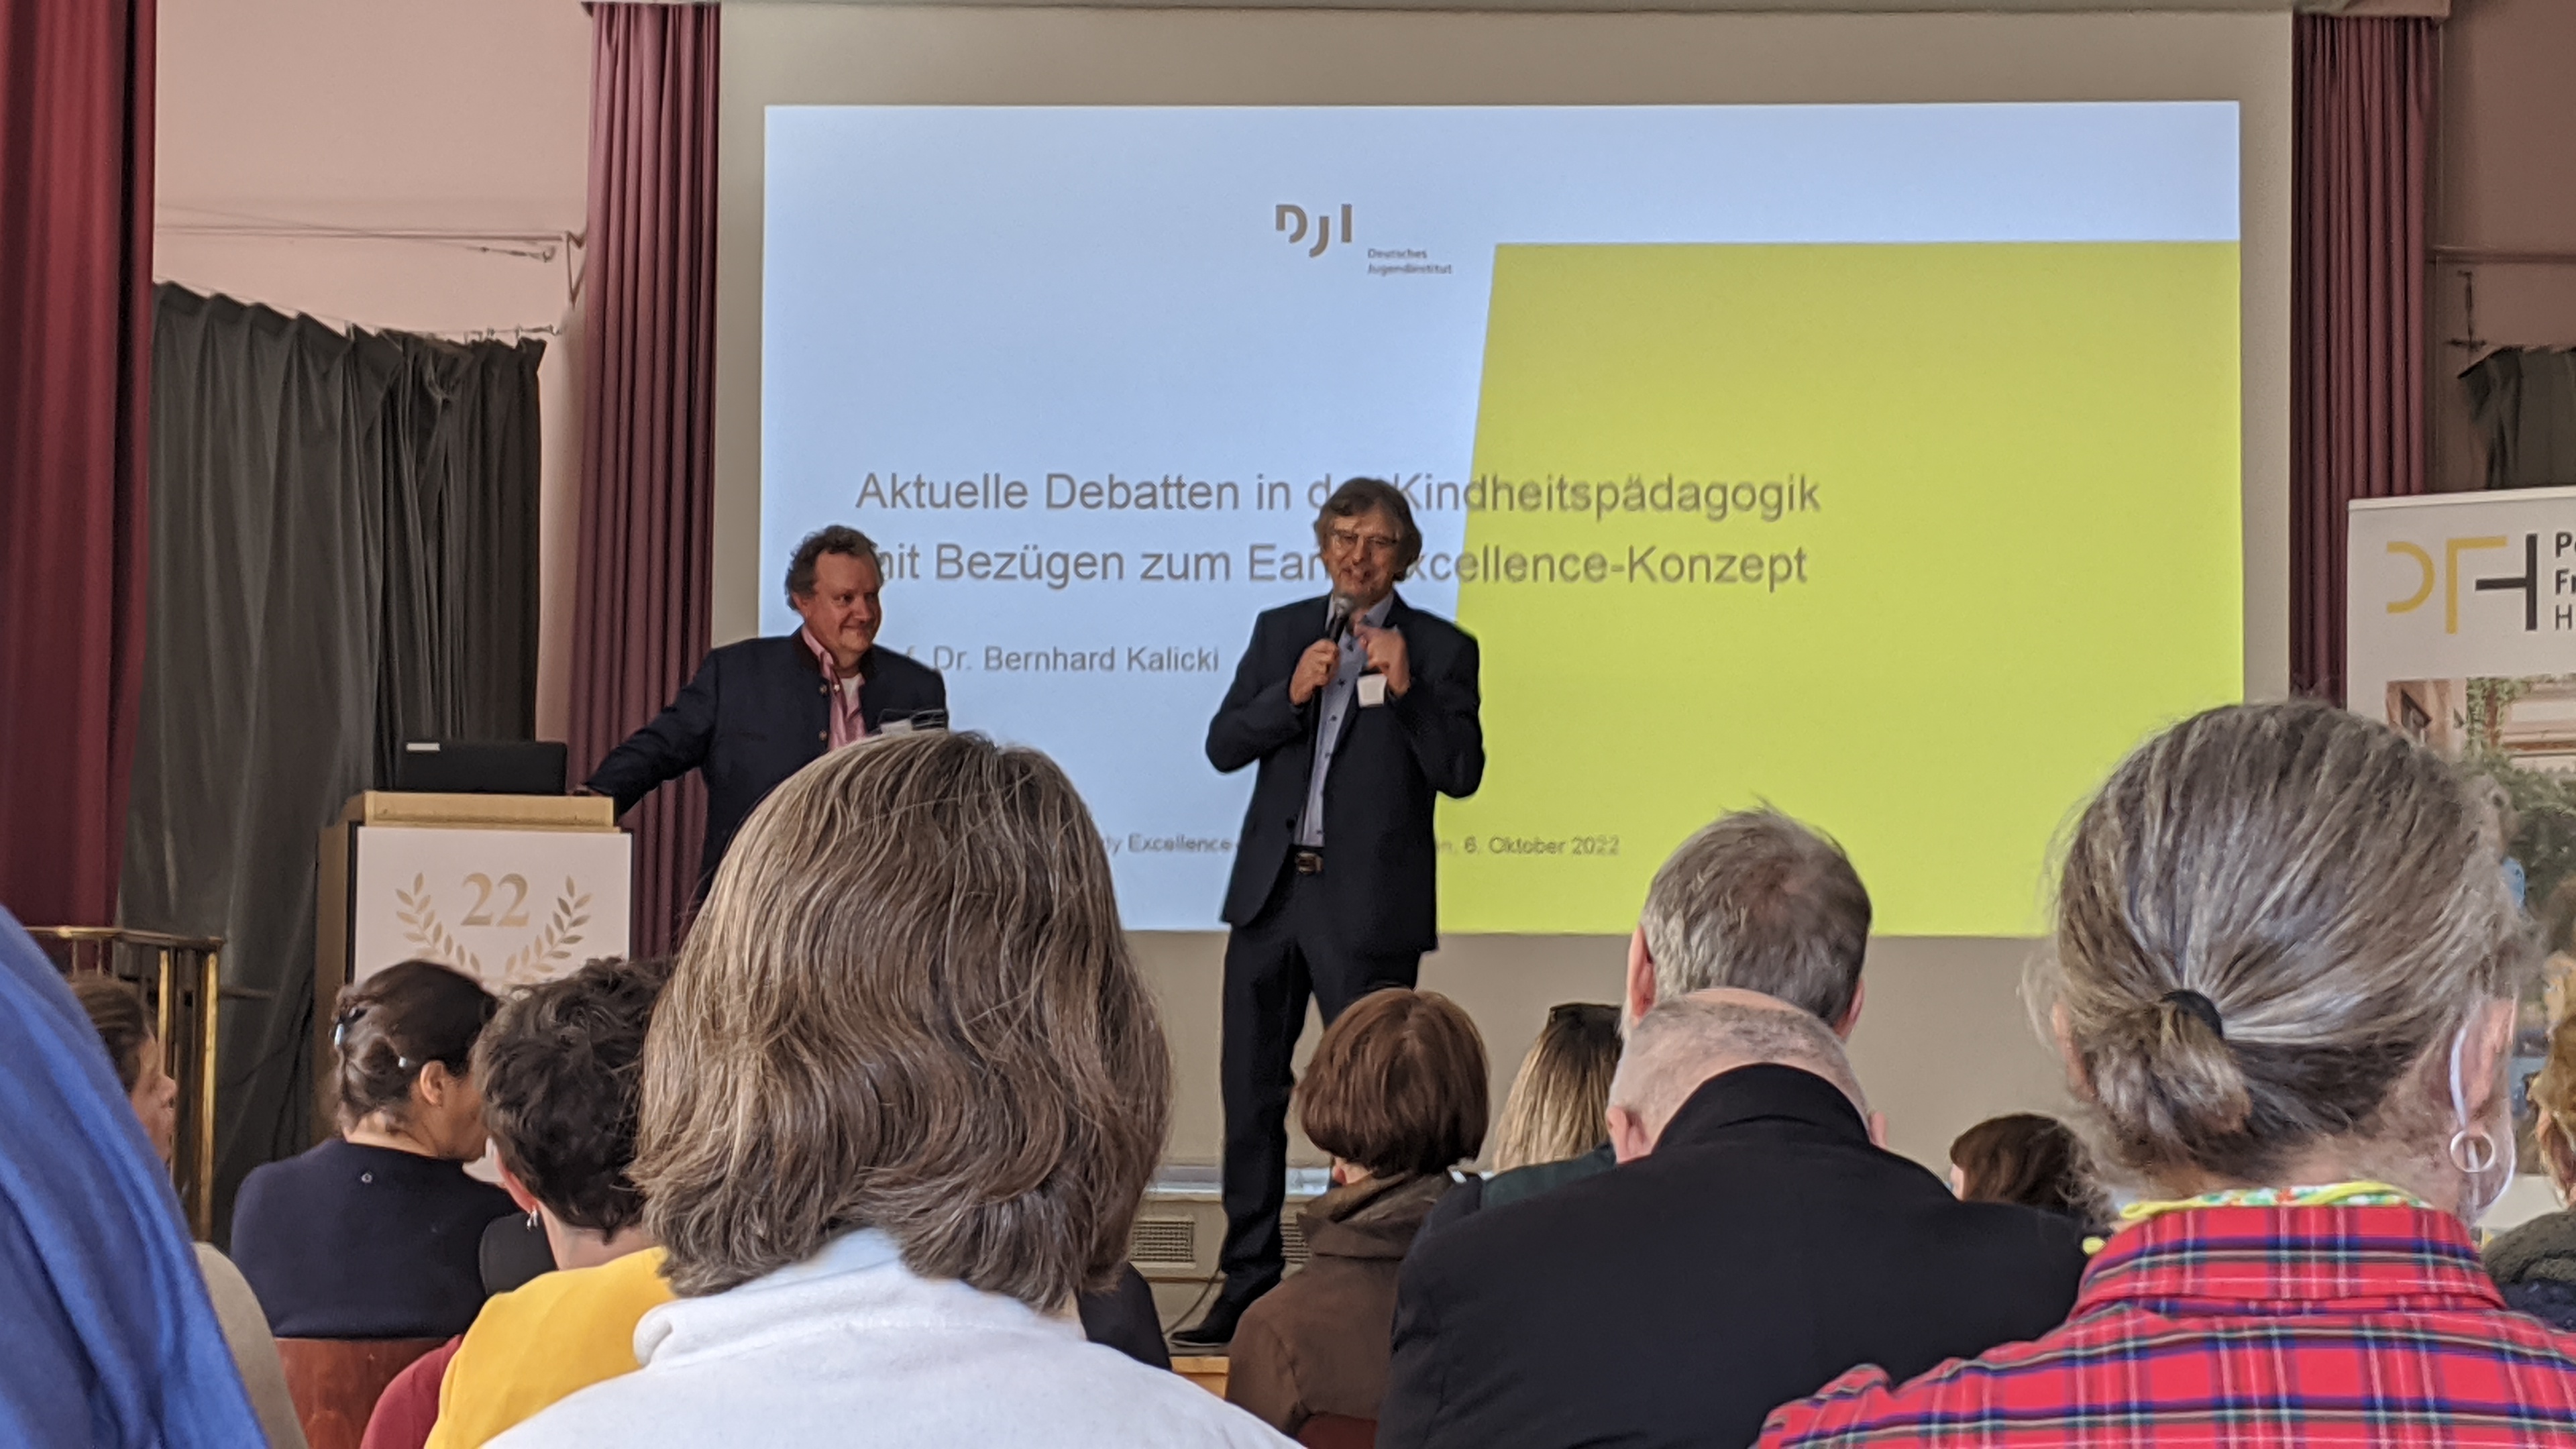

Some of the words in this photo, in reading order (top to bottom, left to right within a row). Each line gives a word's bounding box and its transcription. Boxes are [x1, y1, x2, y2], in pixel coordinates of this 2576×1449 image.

[1275, 203, 1352, 258] DJI
[1368, 248, 1427, 258] Deutsches
[1368, 264, 1452, 276] Jugendinstitut
[856, 472, 1028, 508] Aktuelle
[1046, 473, 1240, 510] Debatten
[1257, 474, 1291, 510] in
[1392, 473, 1821, 523] Kindheitspädagogik
[936, 543, 1124, 590] Bezügen
[1140, 551, 1230, 580] zum
[1407, 544, 1807, 593] xcellence-Konzept
[934, 646, 971, 670] Dr.
[985, 646, 1115, 672] Bernhard
[1128, 646, 1218, 672] Kalicki
[1489, 836, 1566, 855] Oktober
[1571, 835, 1619, 855] 2022
[461, 873, 531, 927] 22
